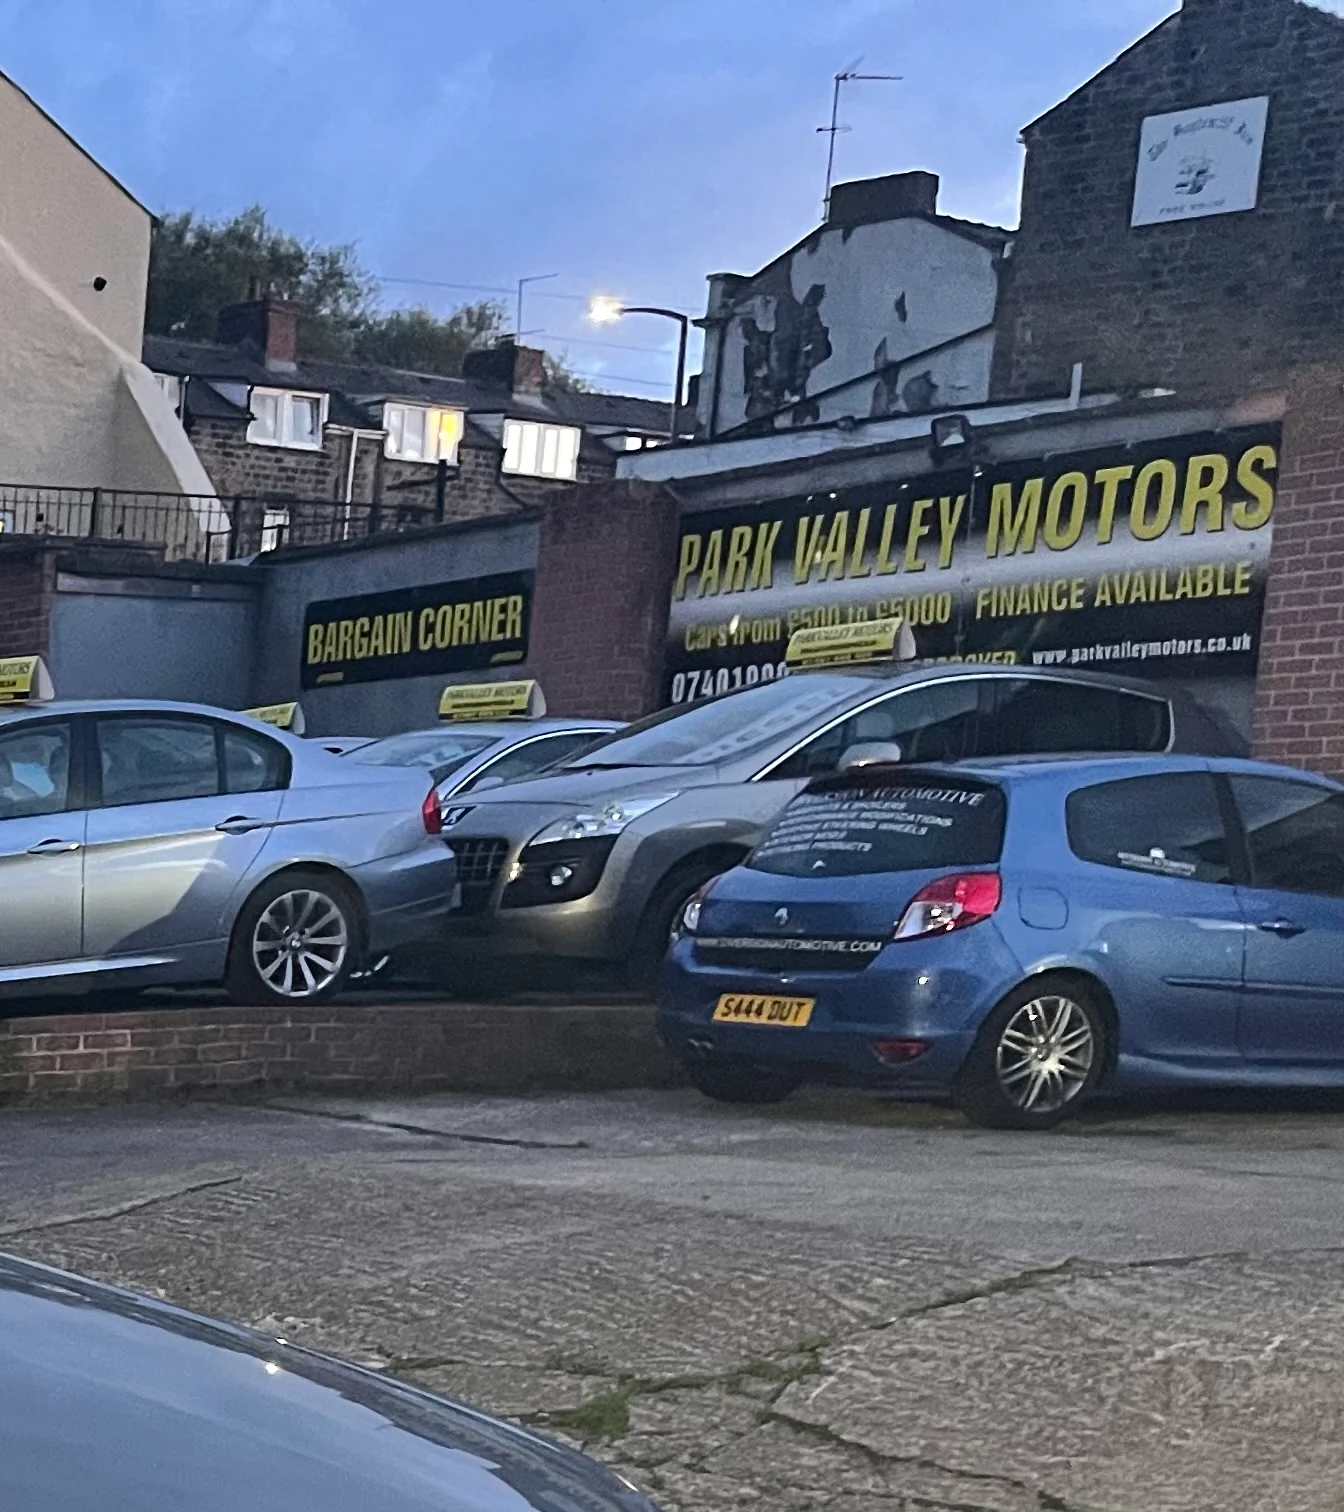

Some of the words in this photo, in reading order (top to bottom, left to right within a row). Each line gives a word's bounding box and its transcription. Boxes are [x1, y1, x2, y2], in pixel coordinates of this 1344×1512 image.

[673, 520, 783, 601] PARK
[793, 494, 966, 585] VALLEY
[986, 445, 1277, 559] MOTORS
[976, 577, 1084, 619] FINANCE
[1095, 561, 1255, 607] AVAILABLE
[307, 611, 413, 665] BARGAIN
[419, 595, 523, 650] CORNER
[1032, 633, 1252, 665] www.parkvalleymotors.co.uk
[697, 937, 882, 952] DIVERSIONAUTOMOTIVE.COM
[721, 997, 766, 1018] S444
